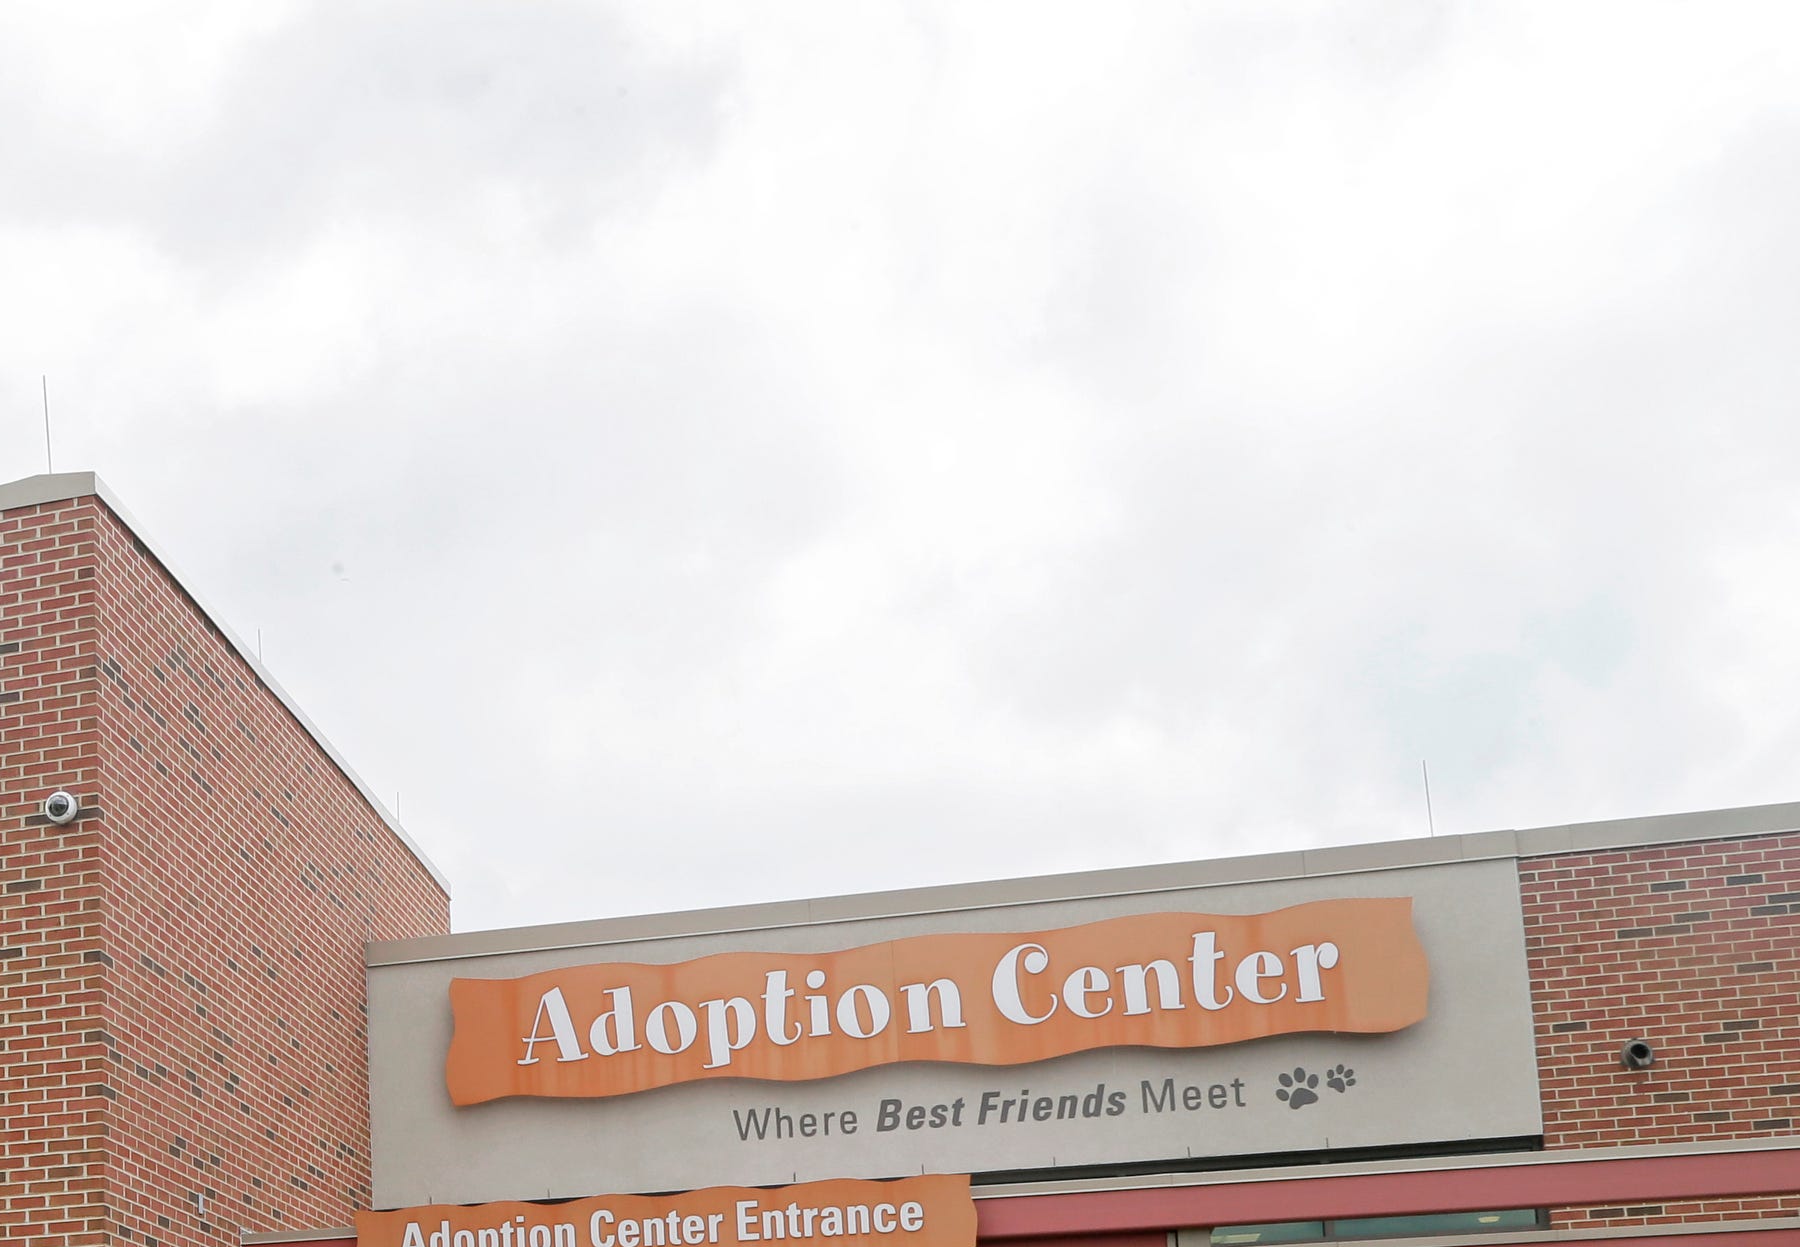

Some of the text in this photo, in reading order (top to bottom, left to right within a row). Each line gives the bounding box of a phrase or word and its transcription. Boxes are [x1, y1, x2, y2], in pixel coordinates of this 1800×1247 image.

[516, 928, 1339, 1070] Adoption Center
[733, 1077, 1247, 1141] Where Best Friends Meet
[737, 1198, 925, 1242] Entrance
